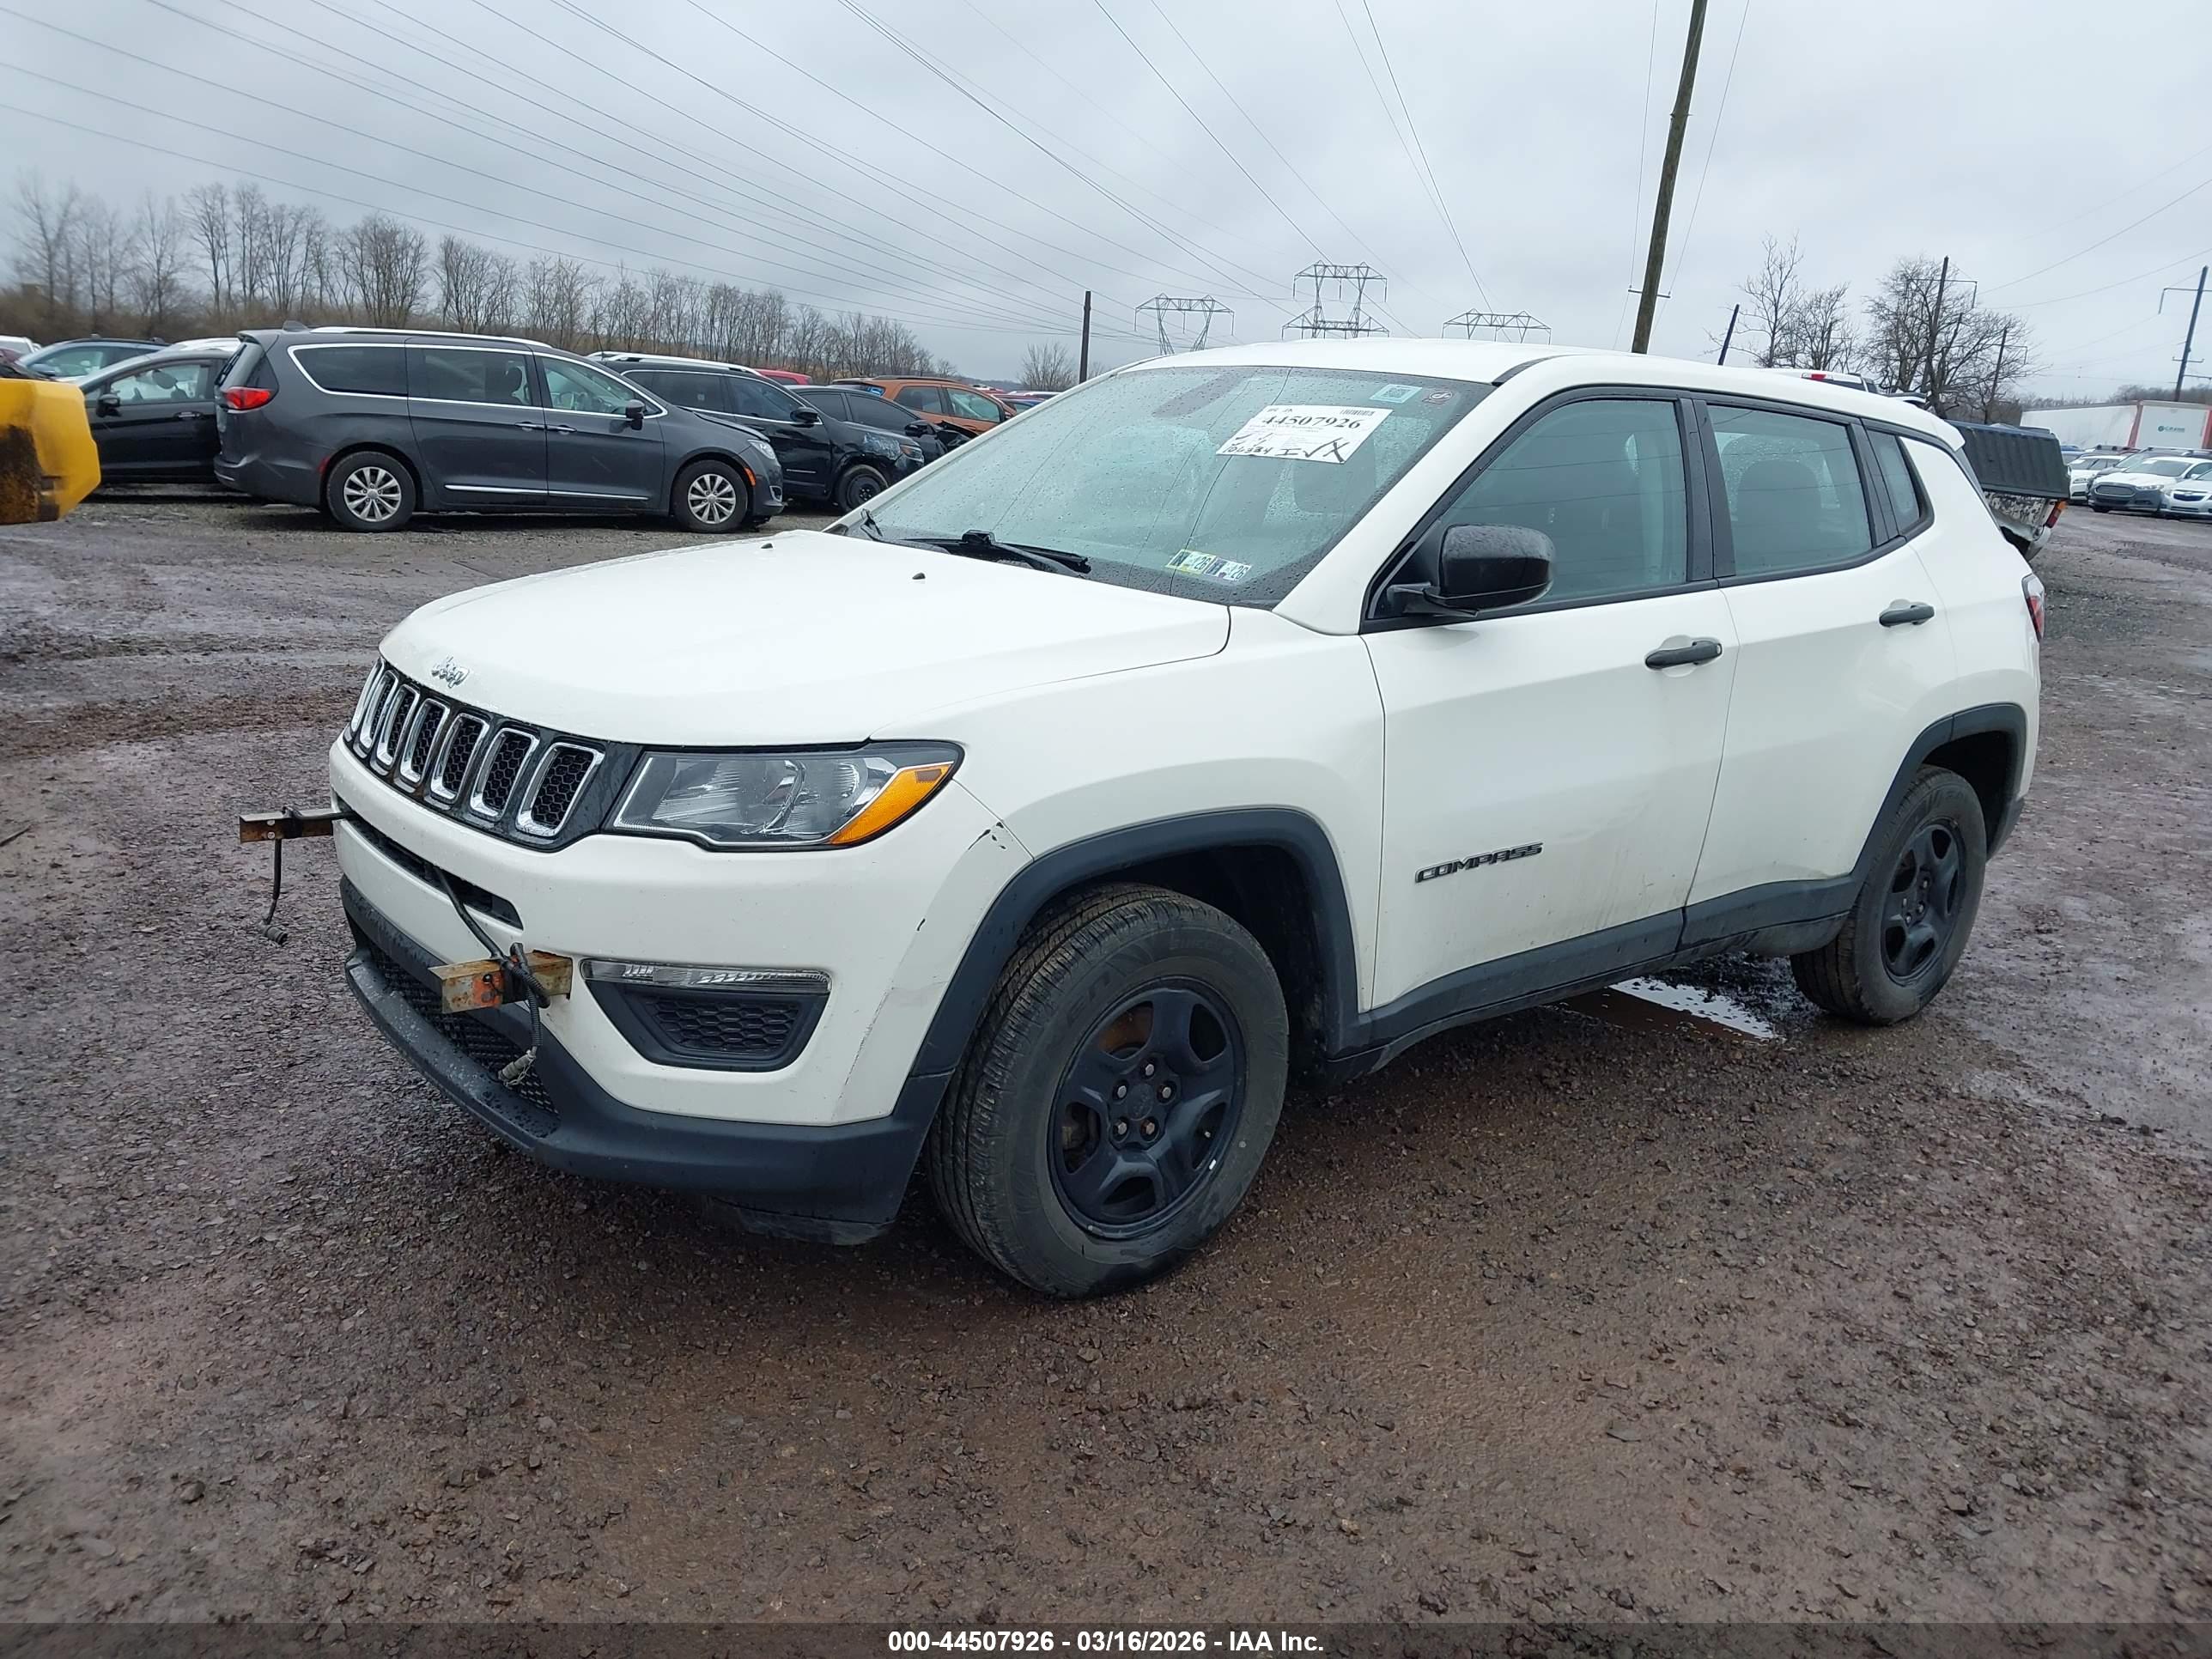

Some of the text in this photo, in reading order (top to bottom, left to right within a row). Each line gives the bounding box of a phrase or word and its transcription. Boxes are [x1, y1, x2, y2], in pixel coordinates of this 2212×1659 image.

[1262, 415, 1361, 429] 44507926
[431, 653, 470, 689] Jeep
[1415, 842, 1544, 884] COMPASS
